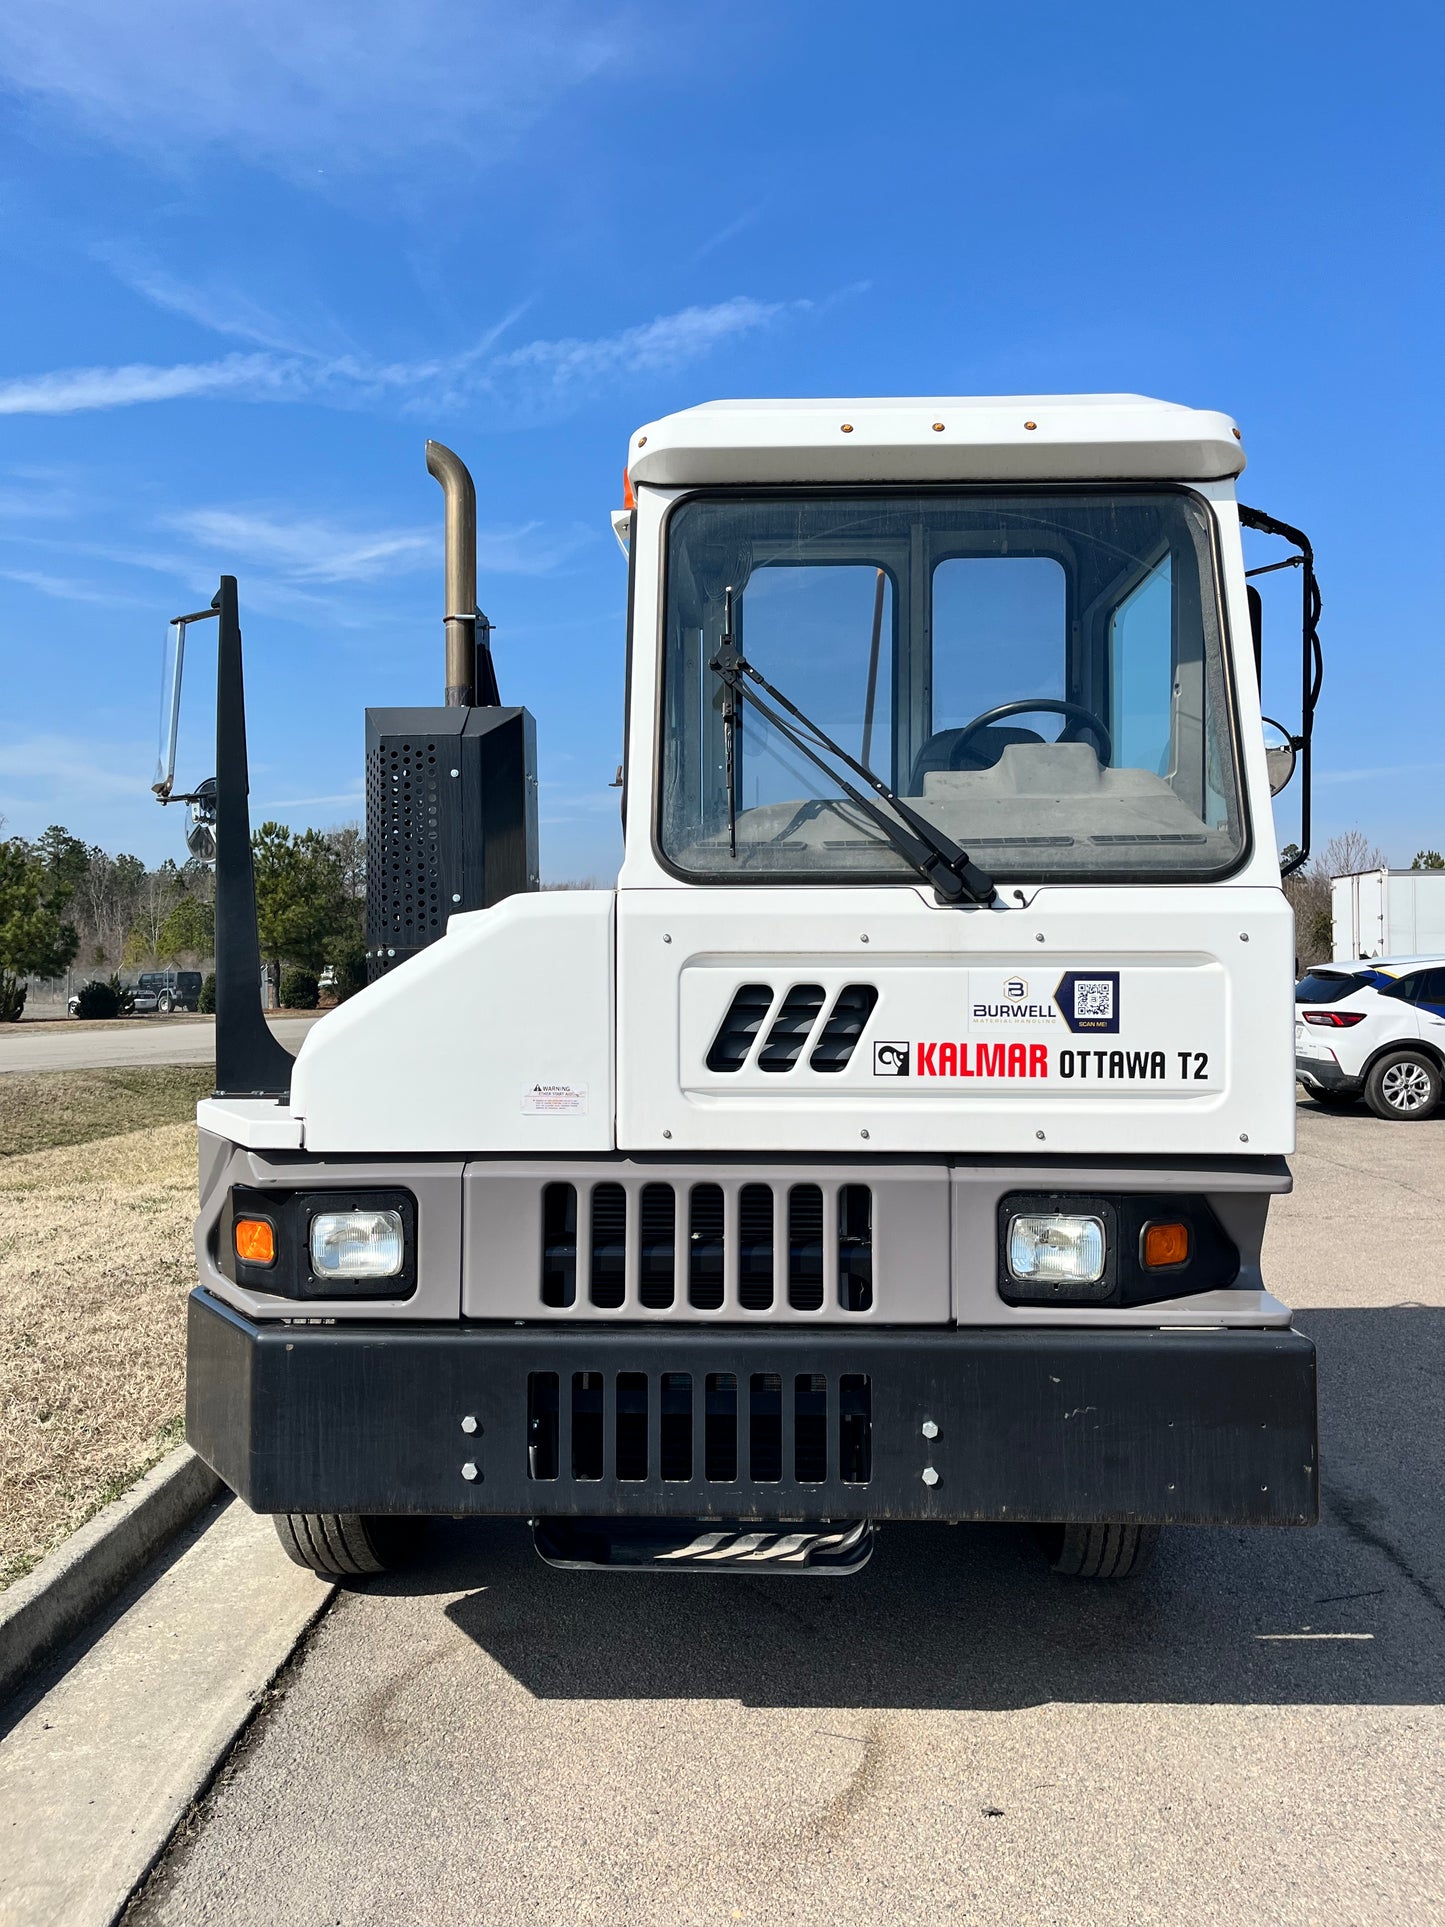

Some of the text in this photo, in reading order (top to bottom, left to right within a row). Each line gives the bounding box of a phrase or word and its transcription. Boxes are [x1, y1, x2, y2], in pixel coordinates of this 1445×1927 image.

[973, 1004, 1057, 1018] BURWELL
[917, 1042, 1209, 1080] KALMAR OTTAWA T2
